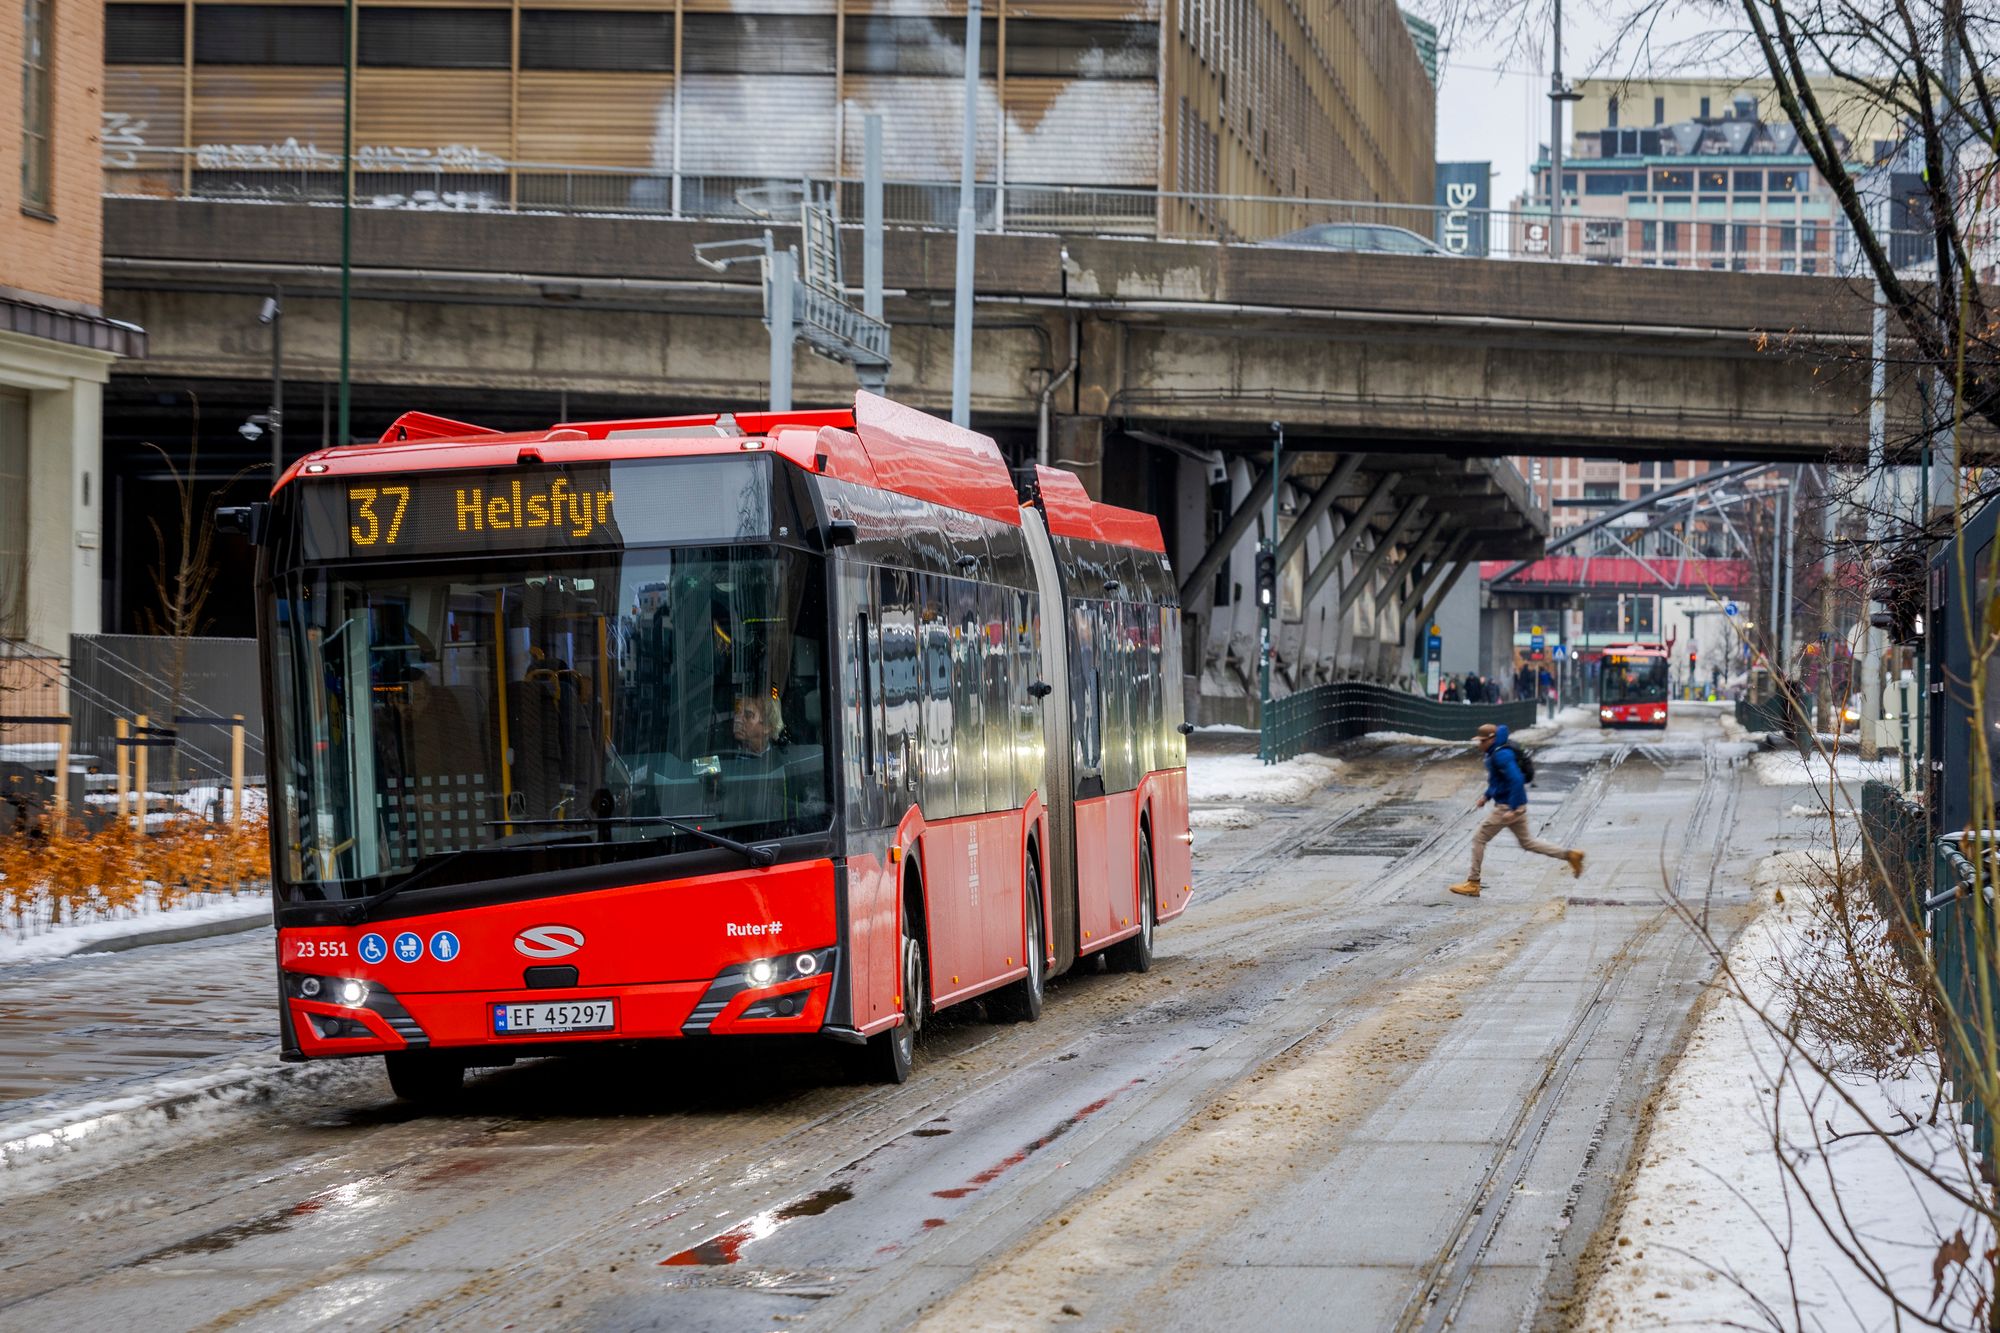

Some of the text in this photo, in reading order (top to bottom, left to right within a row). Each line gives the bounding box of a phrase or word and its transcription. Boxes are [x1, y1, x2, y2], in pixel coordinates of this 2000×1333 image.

[349, 478, 614, 545] 37 Helsfyr
[726, 921, 783, 936] Ruter#
[296, 941, 349, 957] 23 551
[514, 1005, 607, 1027] EF 45297
